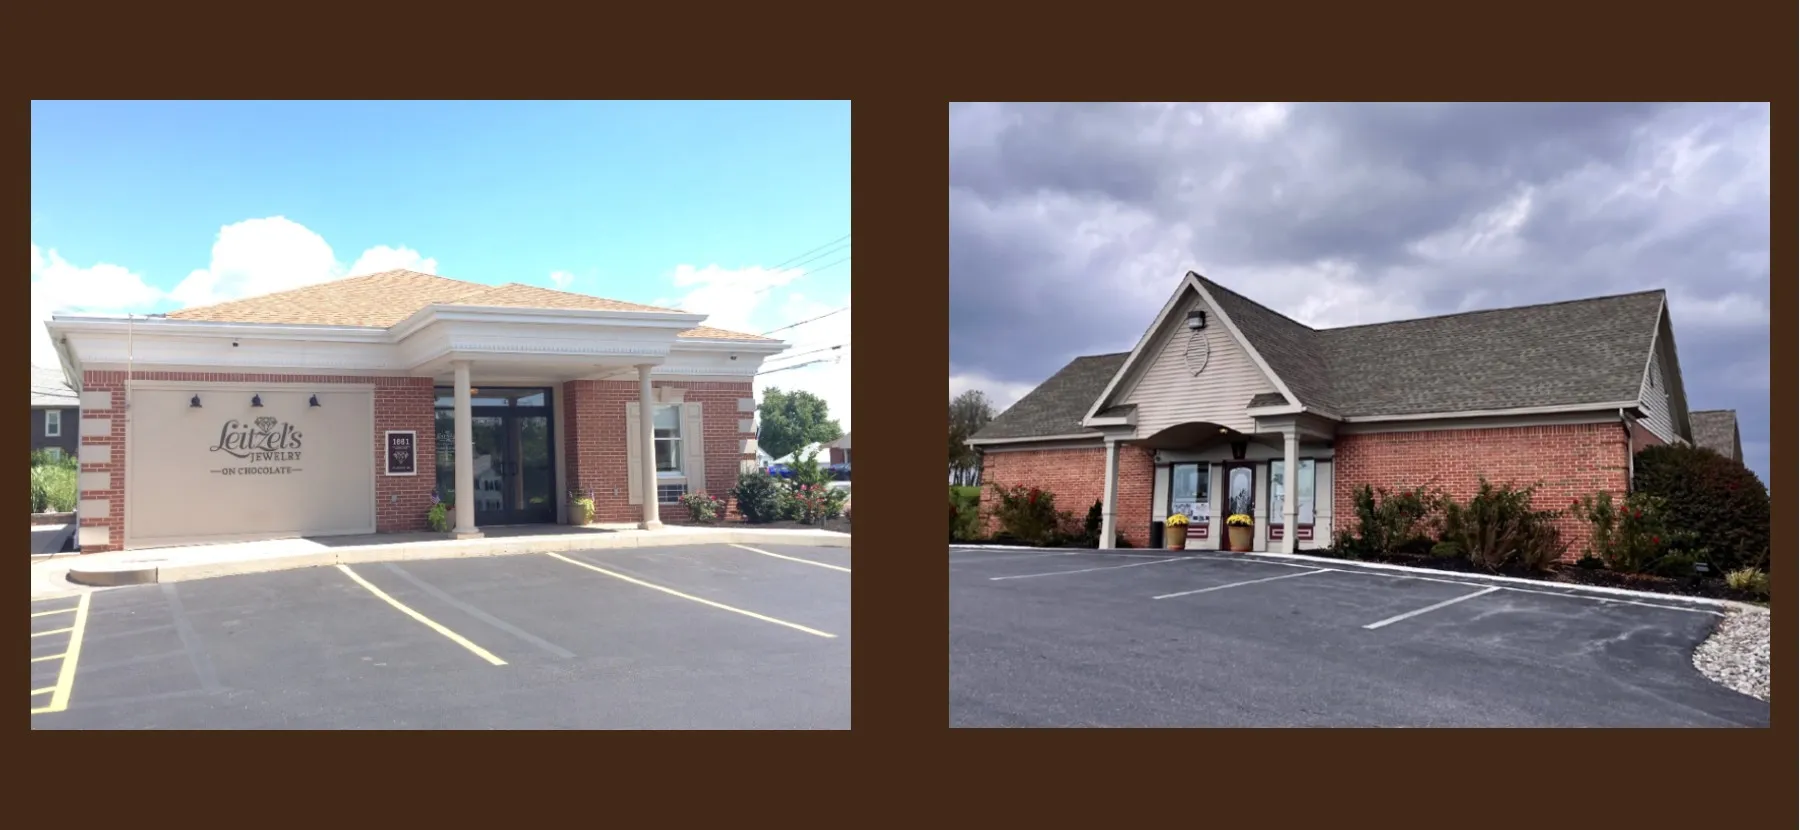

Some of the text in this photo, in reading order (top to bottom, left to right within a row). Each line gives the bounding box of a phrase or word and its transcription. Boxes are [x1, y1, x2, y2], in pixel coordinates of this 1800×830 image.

[210, 419, 303, 459] Leitzel's
[250, 452, 302, 463] JEWELRY
[221, 466, 292, 475] ON CHOCOLATE
